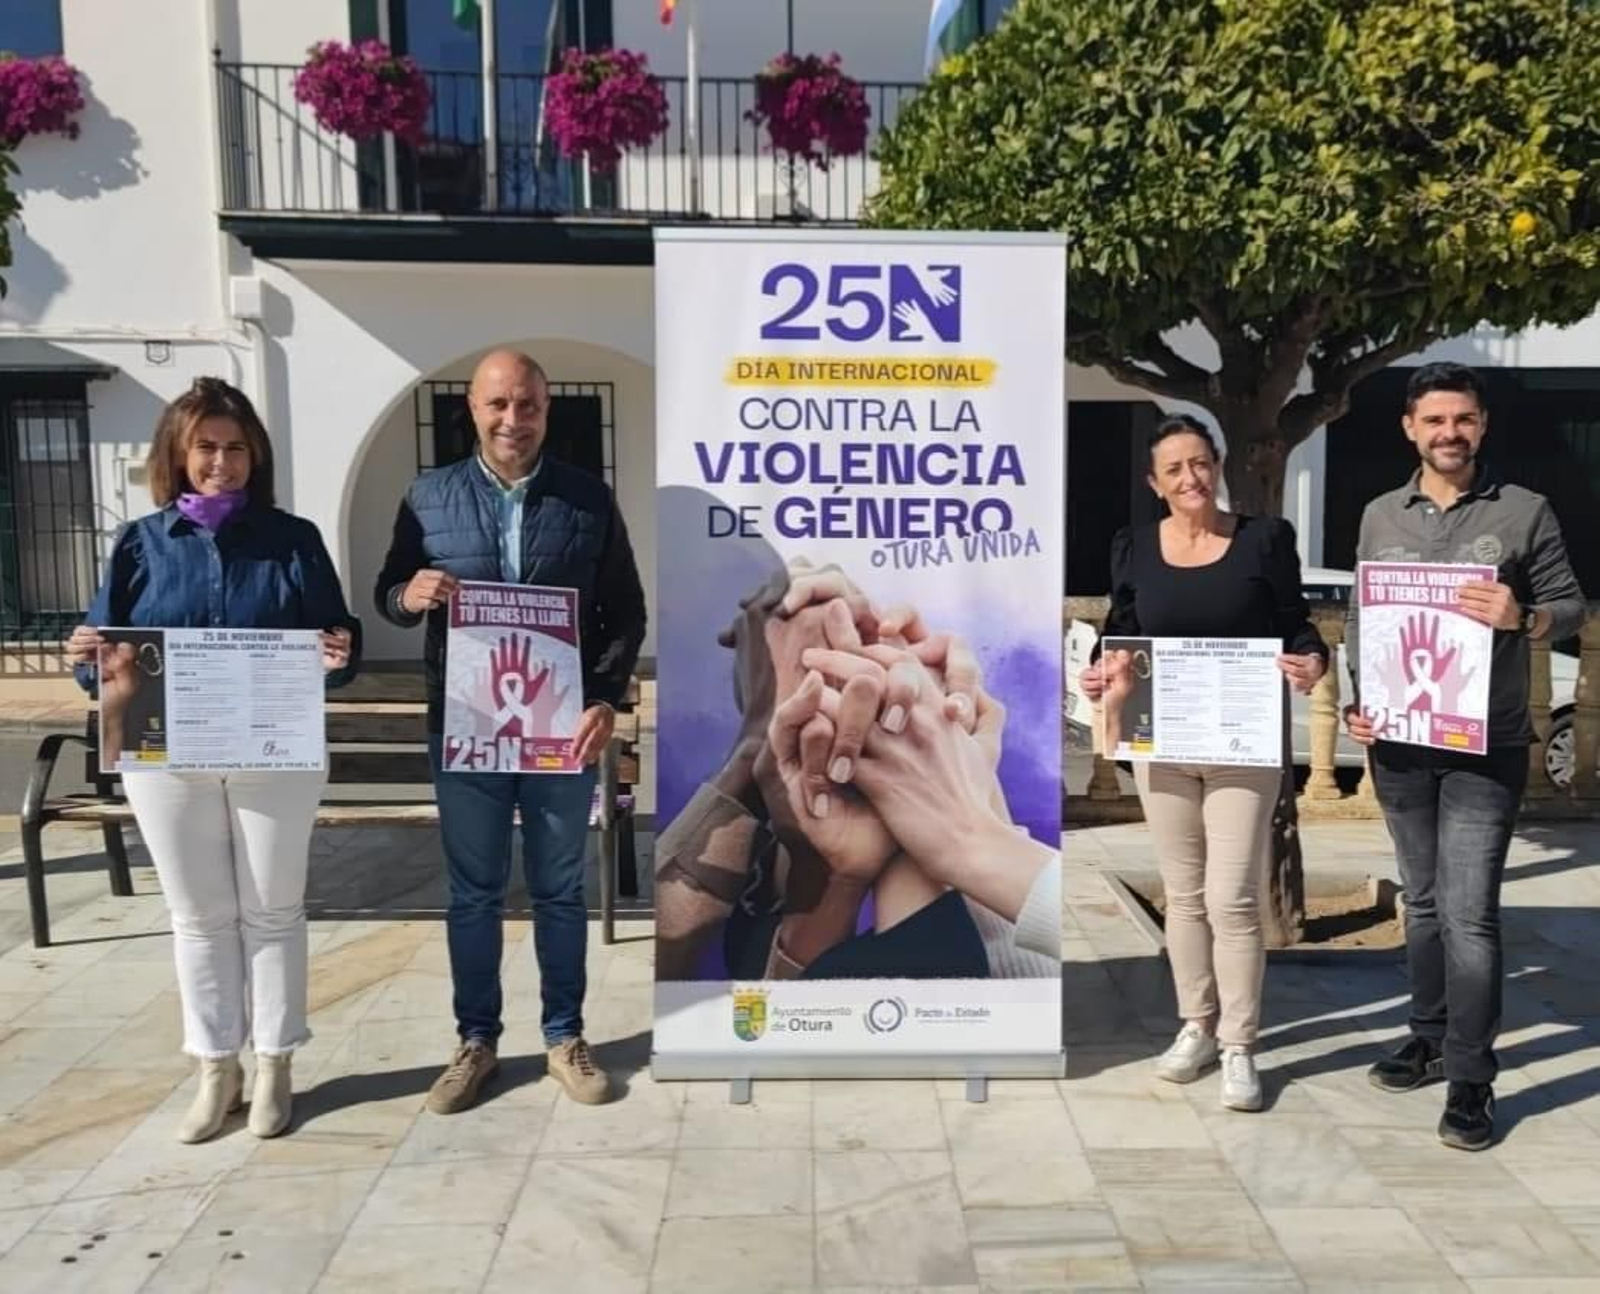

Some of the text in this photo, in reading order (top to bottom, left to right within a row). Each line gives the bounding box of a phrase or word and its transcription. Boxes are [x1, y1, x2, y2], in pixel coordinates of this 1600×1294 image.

[760, 263, 961, 342] 25N
[737, 360, 982, 382] DÍA INTERNACIONAL
[739, 397, 980, 432] CONTRA LA
[694, 442, 1026, 486] VIOLENCIA
[708, 486, 1013, 538] DE GÉNERO
[964, 527, 1041, 563] UNIDA
[1369, 570, 1411, 586] CONTRA
[1412, 571, 1427, 586] LA
[459, 589, 502, 605] CONTRA
[503, 591, 518, 606] LA
[1388, 586, 1430, 603] TIENES
[1431, 587, 1446, 604] LA
[479, 605, 521, 624] TIENES
[523, 608, 537, 625] LA
[1367, 706, 1431, 744] 25N
[450, 737, 521, 771] 25N
[772, 1005, 852, 1020] Ayuntamiento
[788, 1018, 833, 1032] Otura
